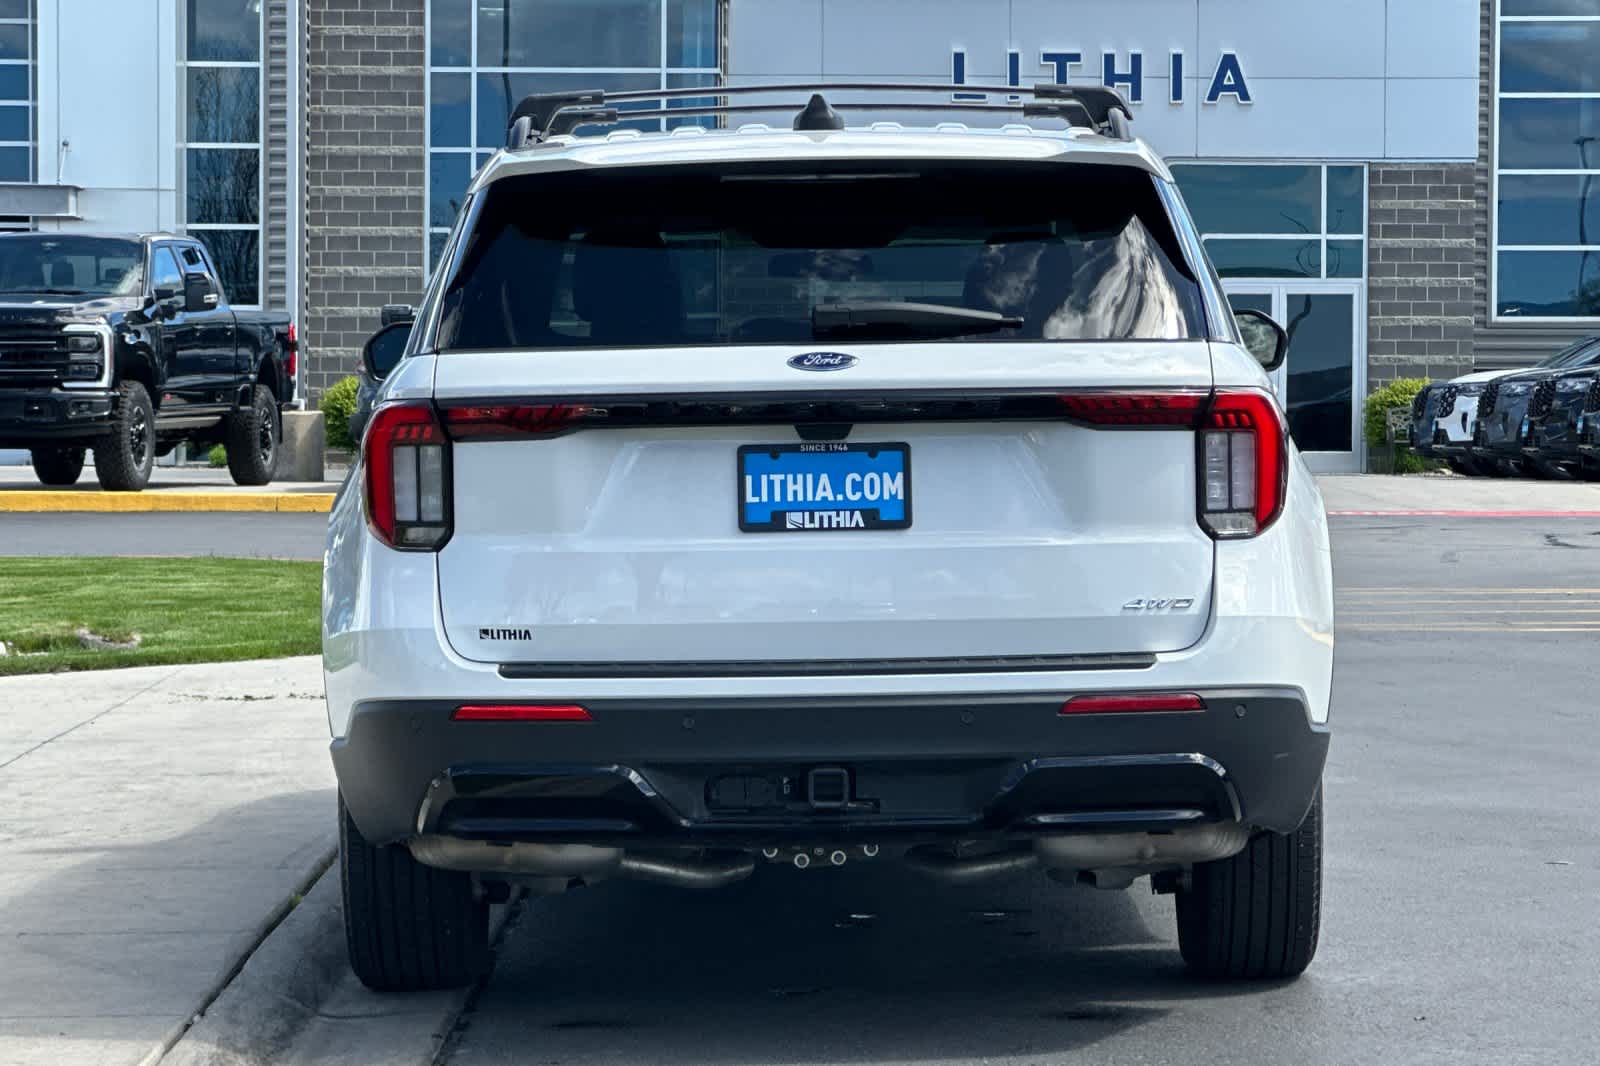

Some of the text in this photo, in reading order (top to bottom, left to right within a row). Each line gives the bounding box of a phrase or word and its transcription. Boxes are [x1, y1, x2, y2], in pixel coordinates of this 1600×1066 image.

[952, 49, 1252, 103] LITHIA
[803, 354, 842, 365] Ford
[745, 472, 904, 503] LITHIA.COM
[804, 511, 865, 528] LITHIA
[1122, 598, 1194, 609] 4WD
[490, 629, 532, 640] LITHIA
